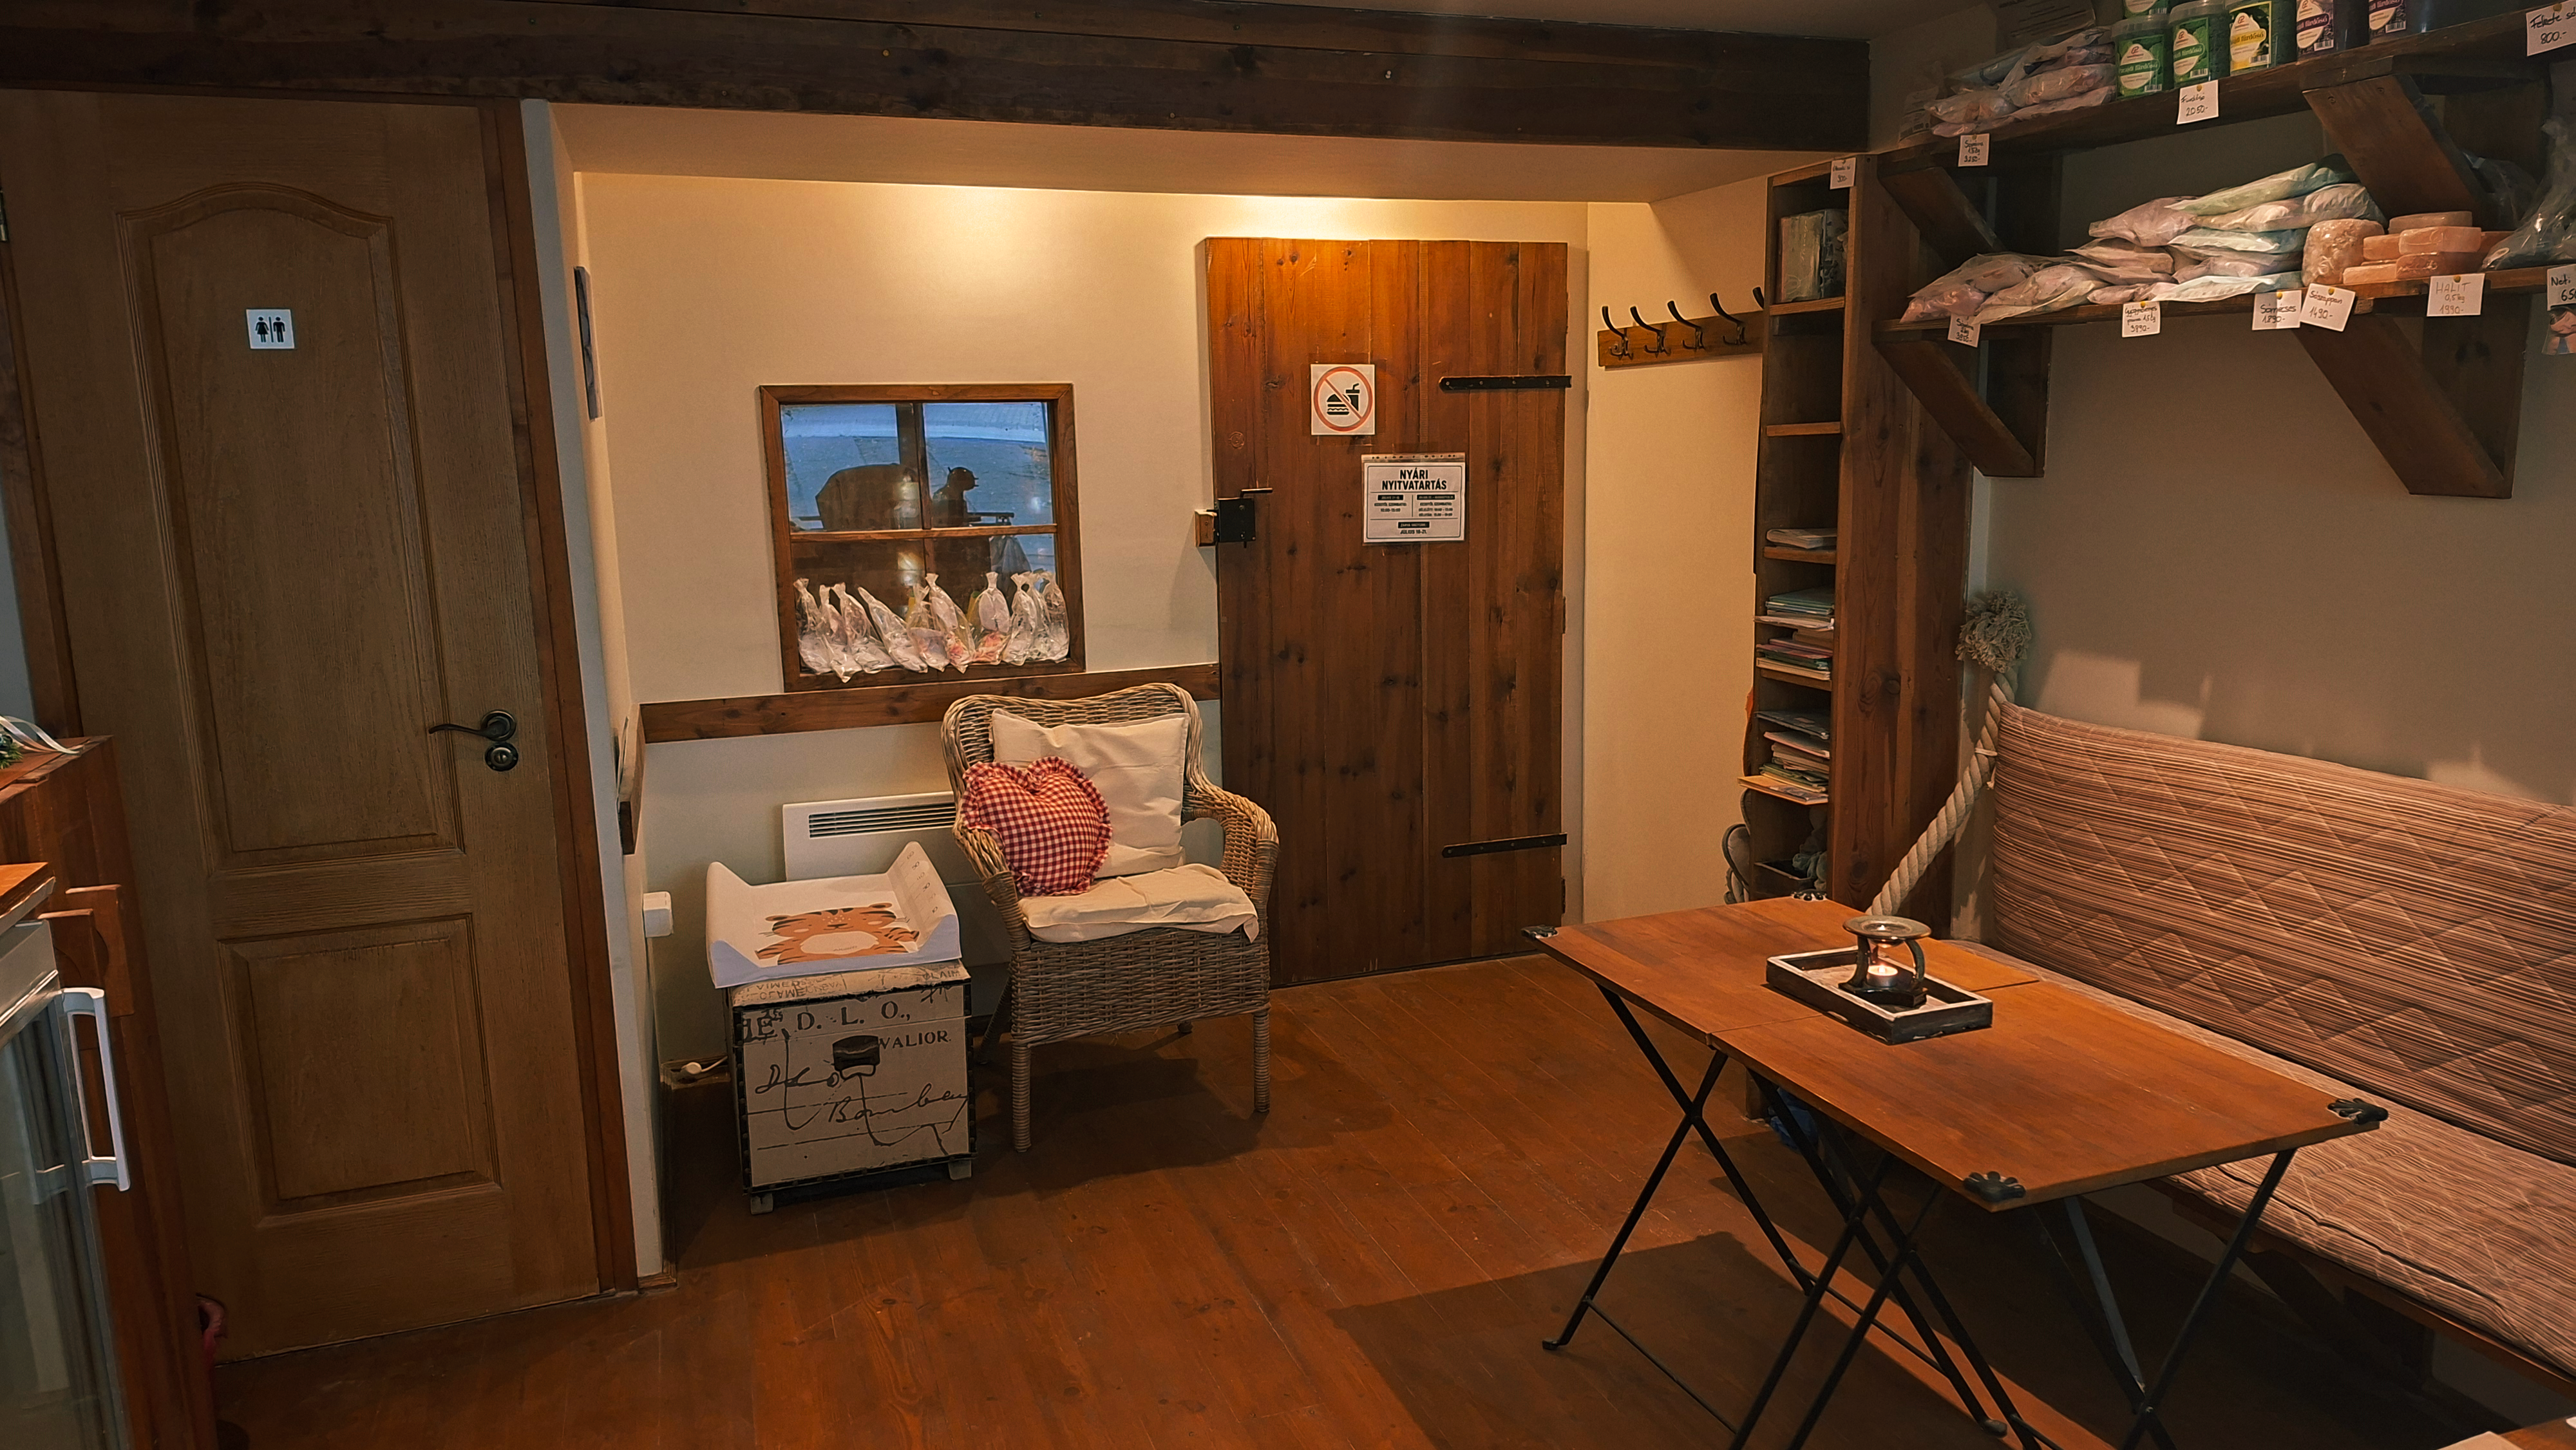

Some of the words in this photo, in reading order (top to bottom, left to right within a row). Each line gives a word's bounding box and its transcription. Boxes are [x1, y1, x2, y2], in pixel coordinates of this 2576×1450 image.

[2436, 281, 2472, 294] HALIT
[1399, 467, 1428, 480] NYÁRI
[1381, 478, 1447, 490] NYITVATARTÁS
